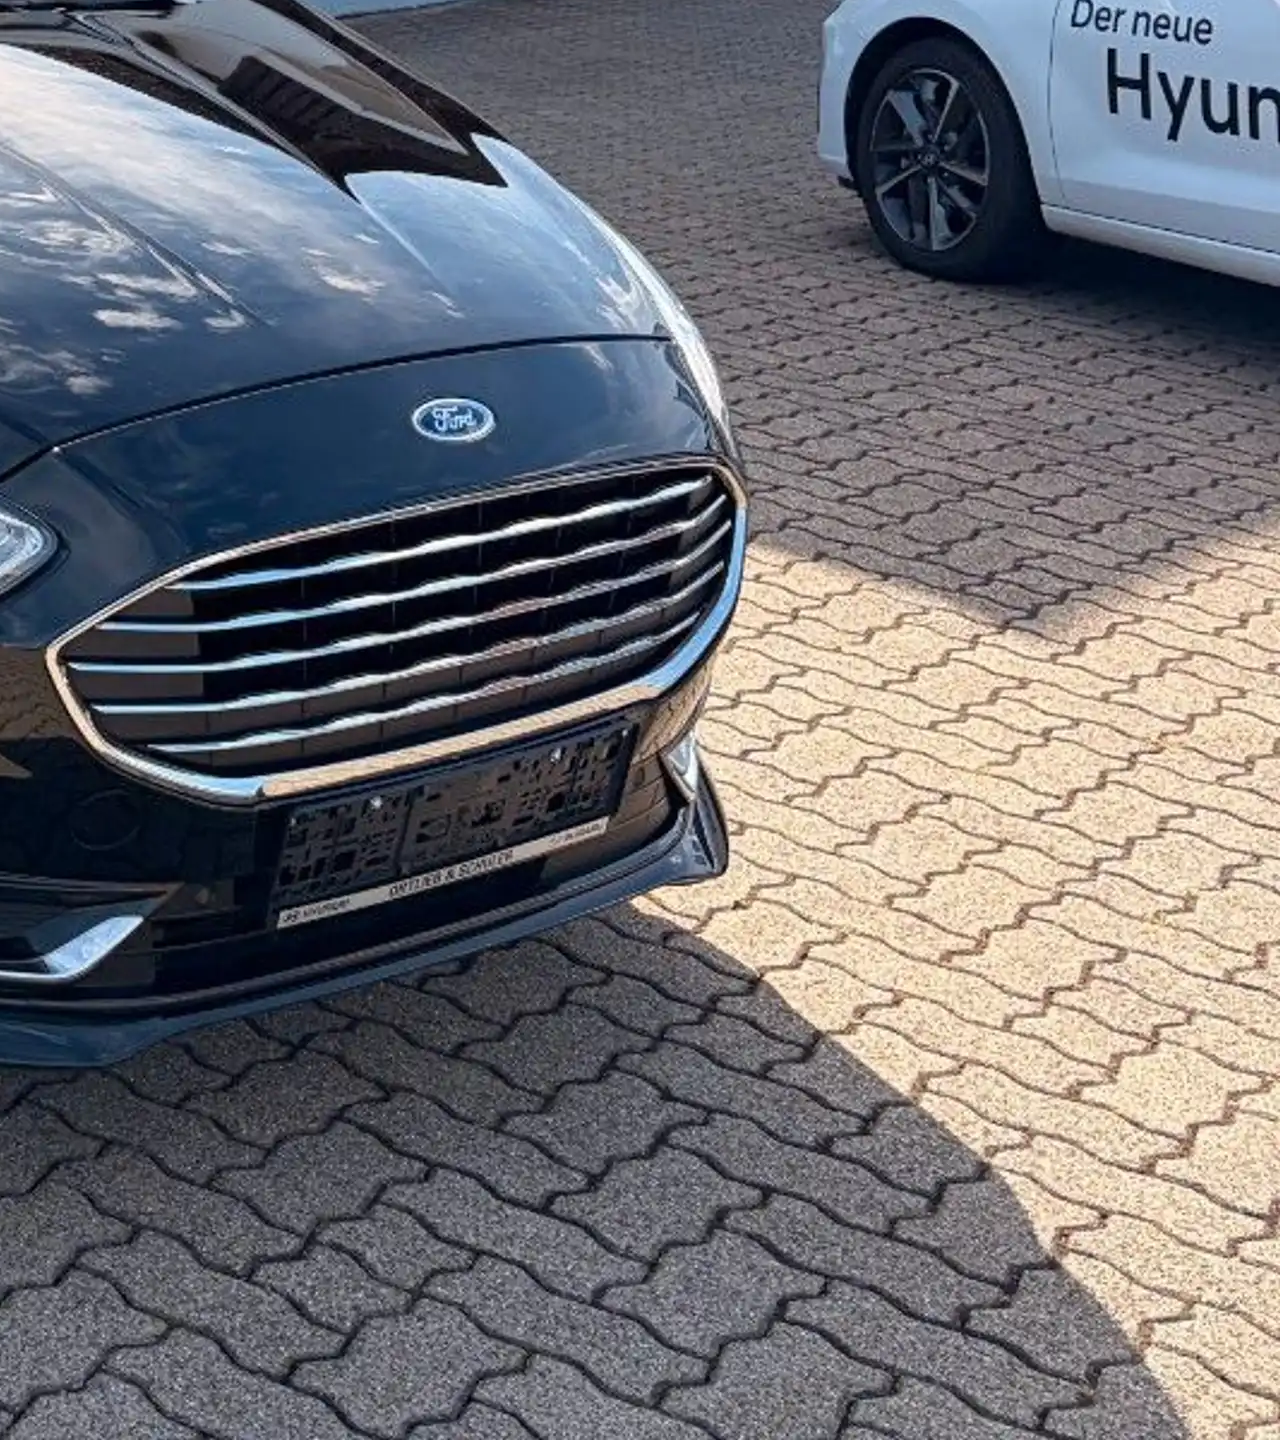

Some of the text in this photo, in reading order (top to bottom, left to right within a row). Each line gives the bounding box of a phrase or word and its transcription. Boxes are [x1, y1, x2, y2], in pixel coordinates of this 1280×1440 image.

[1131, 10, 1213, 45] neue
[1107, 47, 1280, 143] Hyun
[432, 406, 477, 432] Ford
